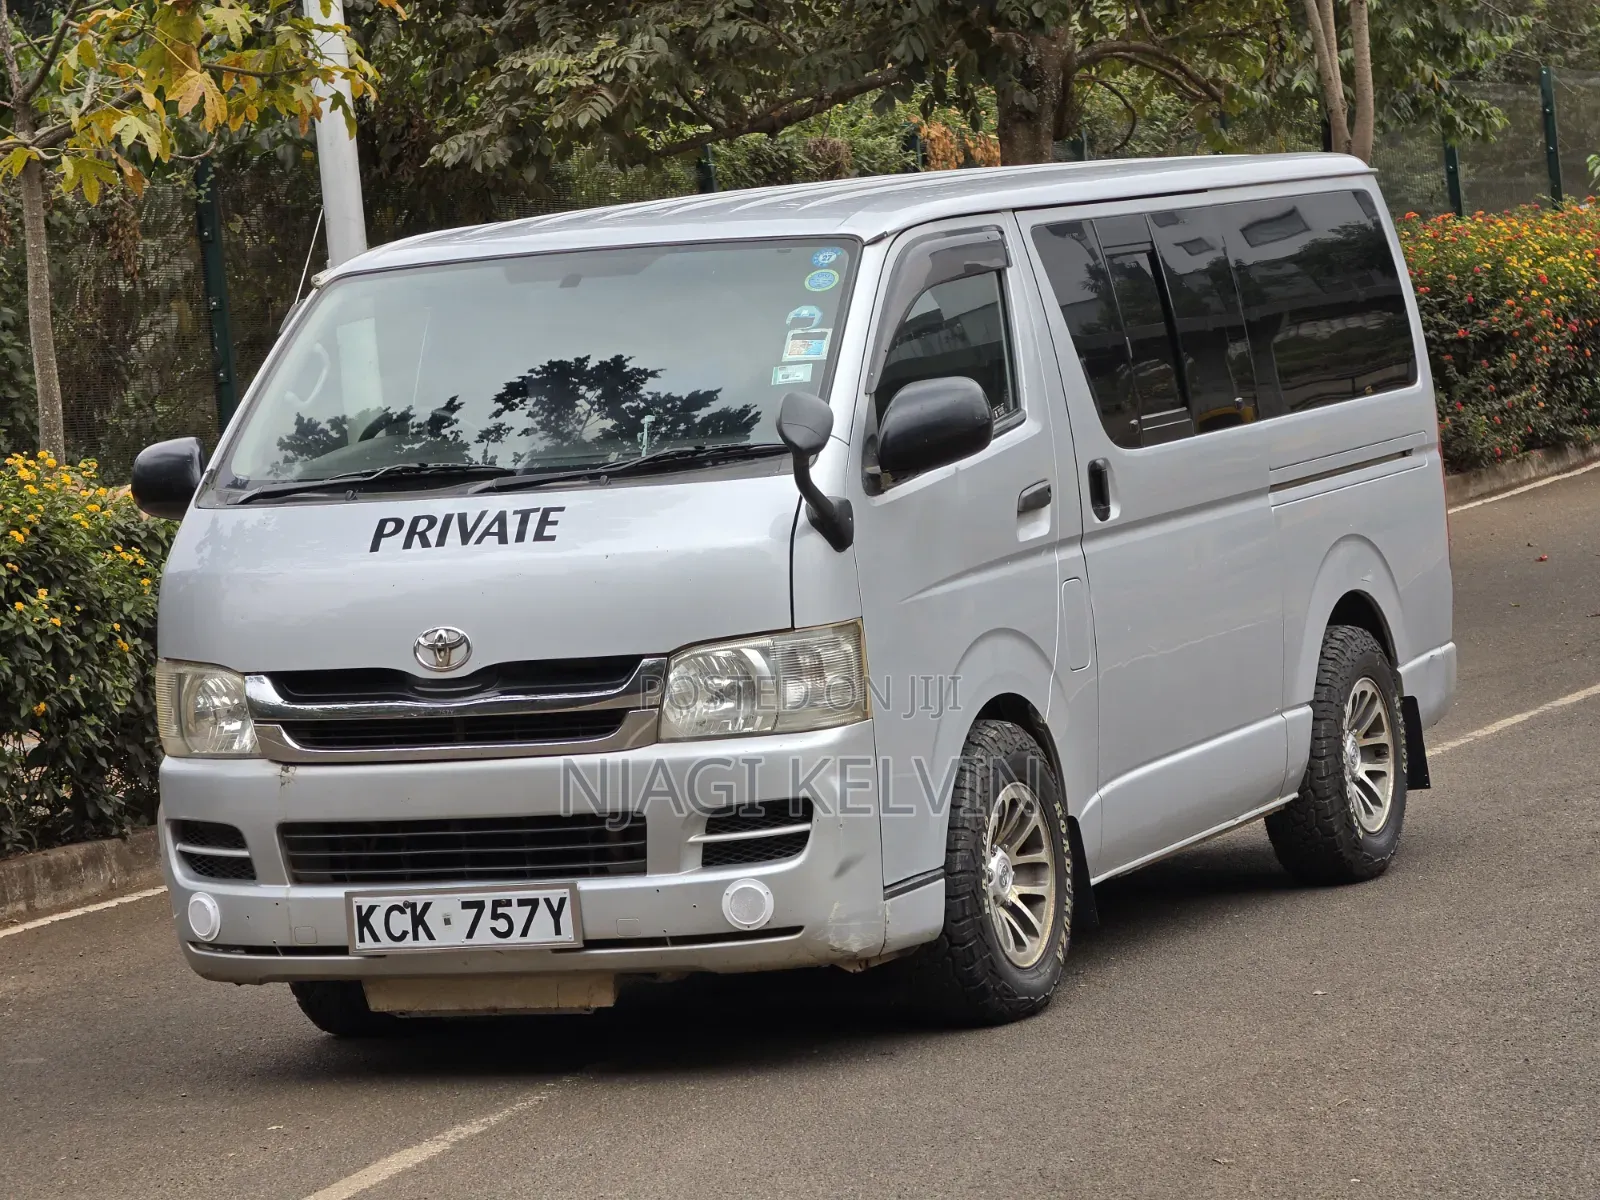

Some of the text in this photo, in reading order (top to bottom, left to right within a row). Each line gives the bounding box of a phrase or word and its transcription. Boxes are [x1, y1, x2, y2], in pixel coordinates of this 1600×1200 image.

[369, 506, 566, 553] PRIVATE
[355, 896, 568, 943] KCK 757Y
